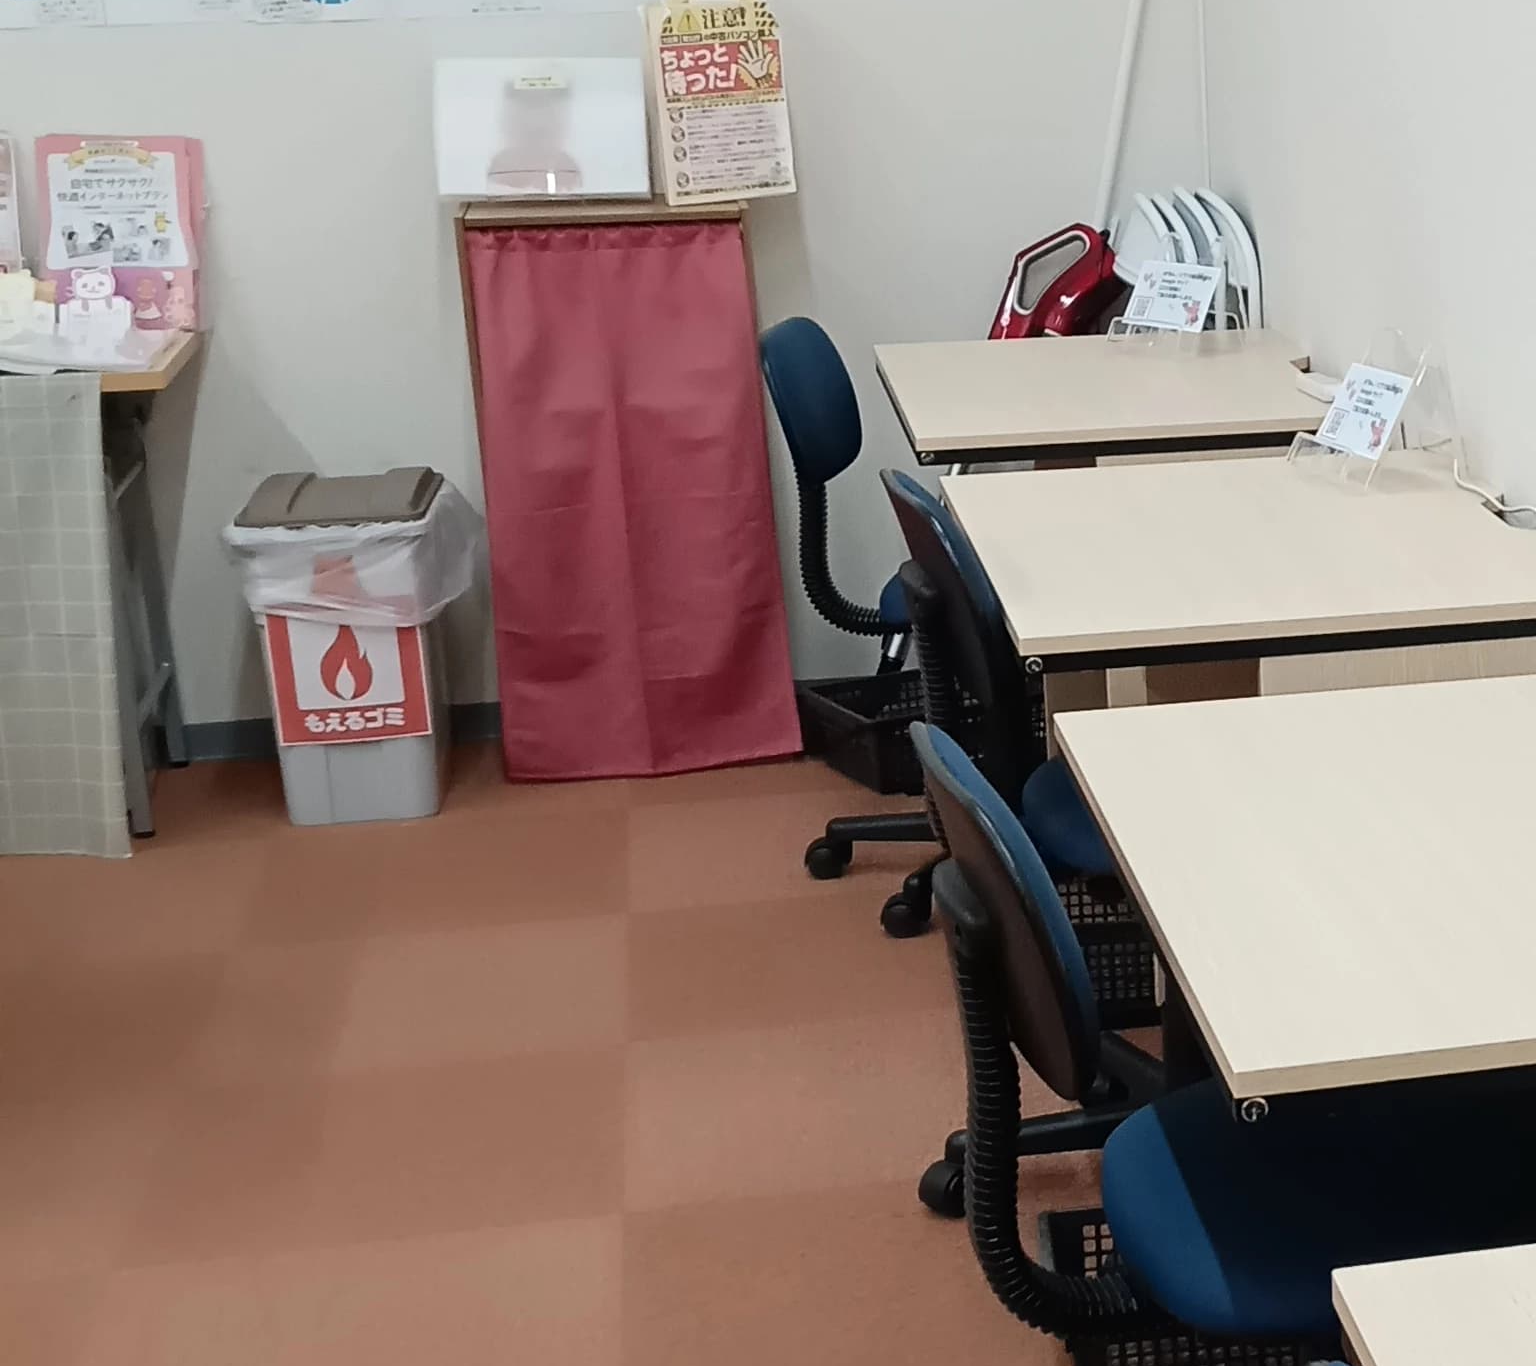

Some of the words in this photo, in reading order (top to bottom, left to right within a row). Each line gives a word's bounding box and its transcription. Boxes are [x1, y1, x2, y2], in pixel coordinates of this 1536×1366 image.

[660, 42, 730, 71] ちょっと
[304, 706, 407, 735] もえるゴミ
